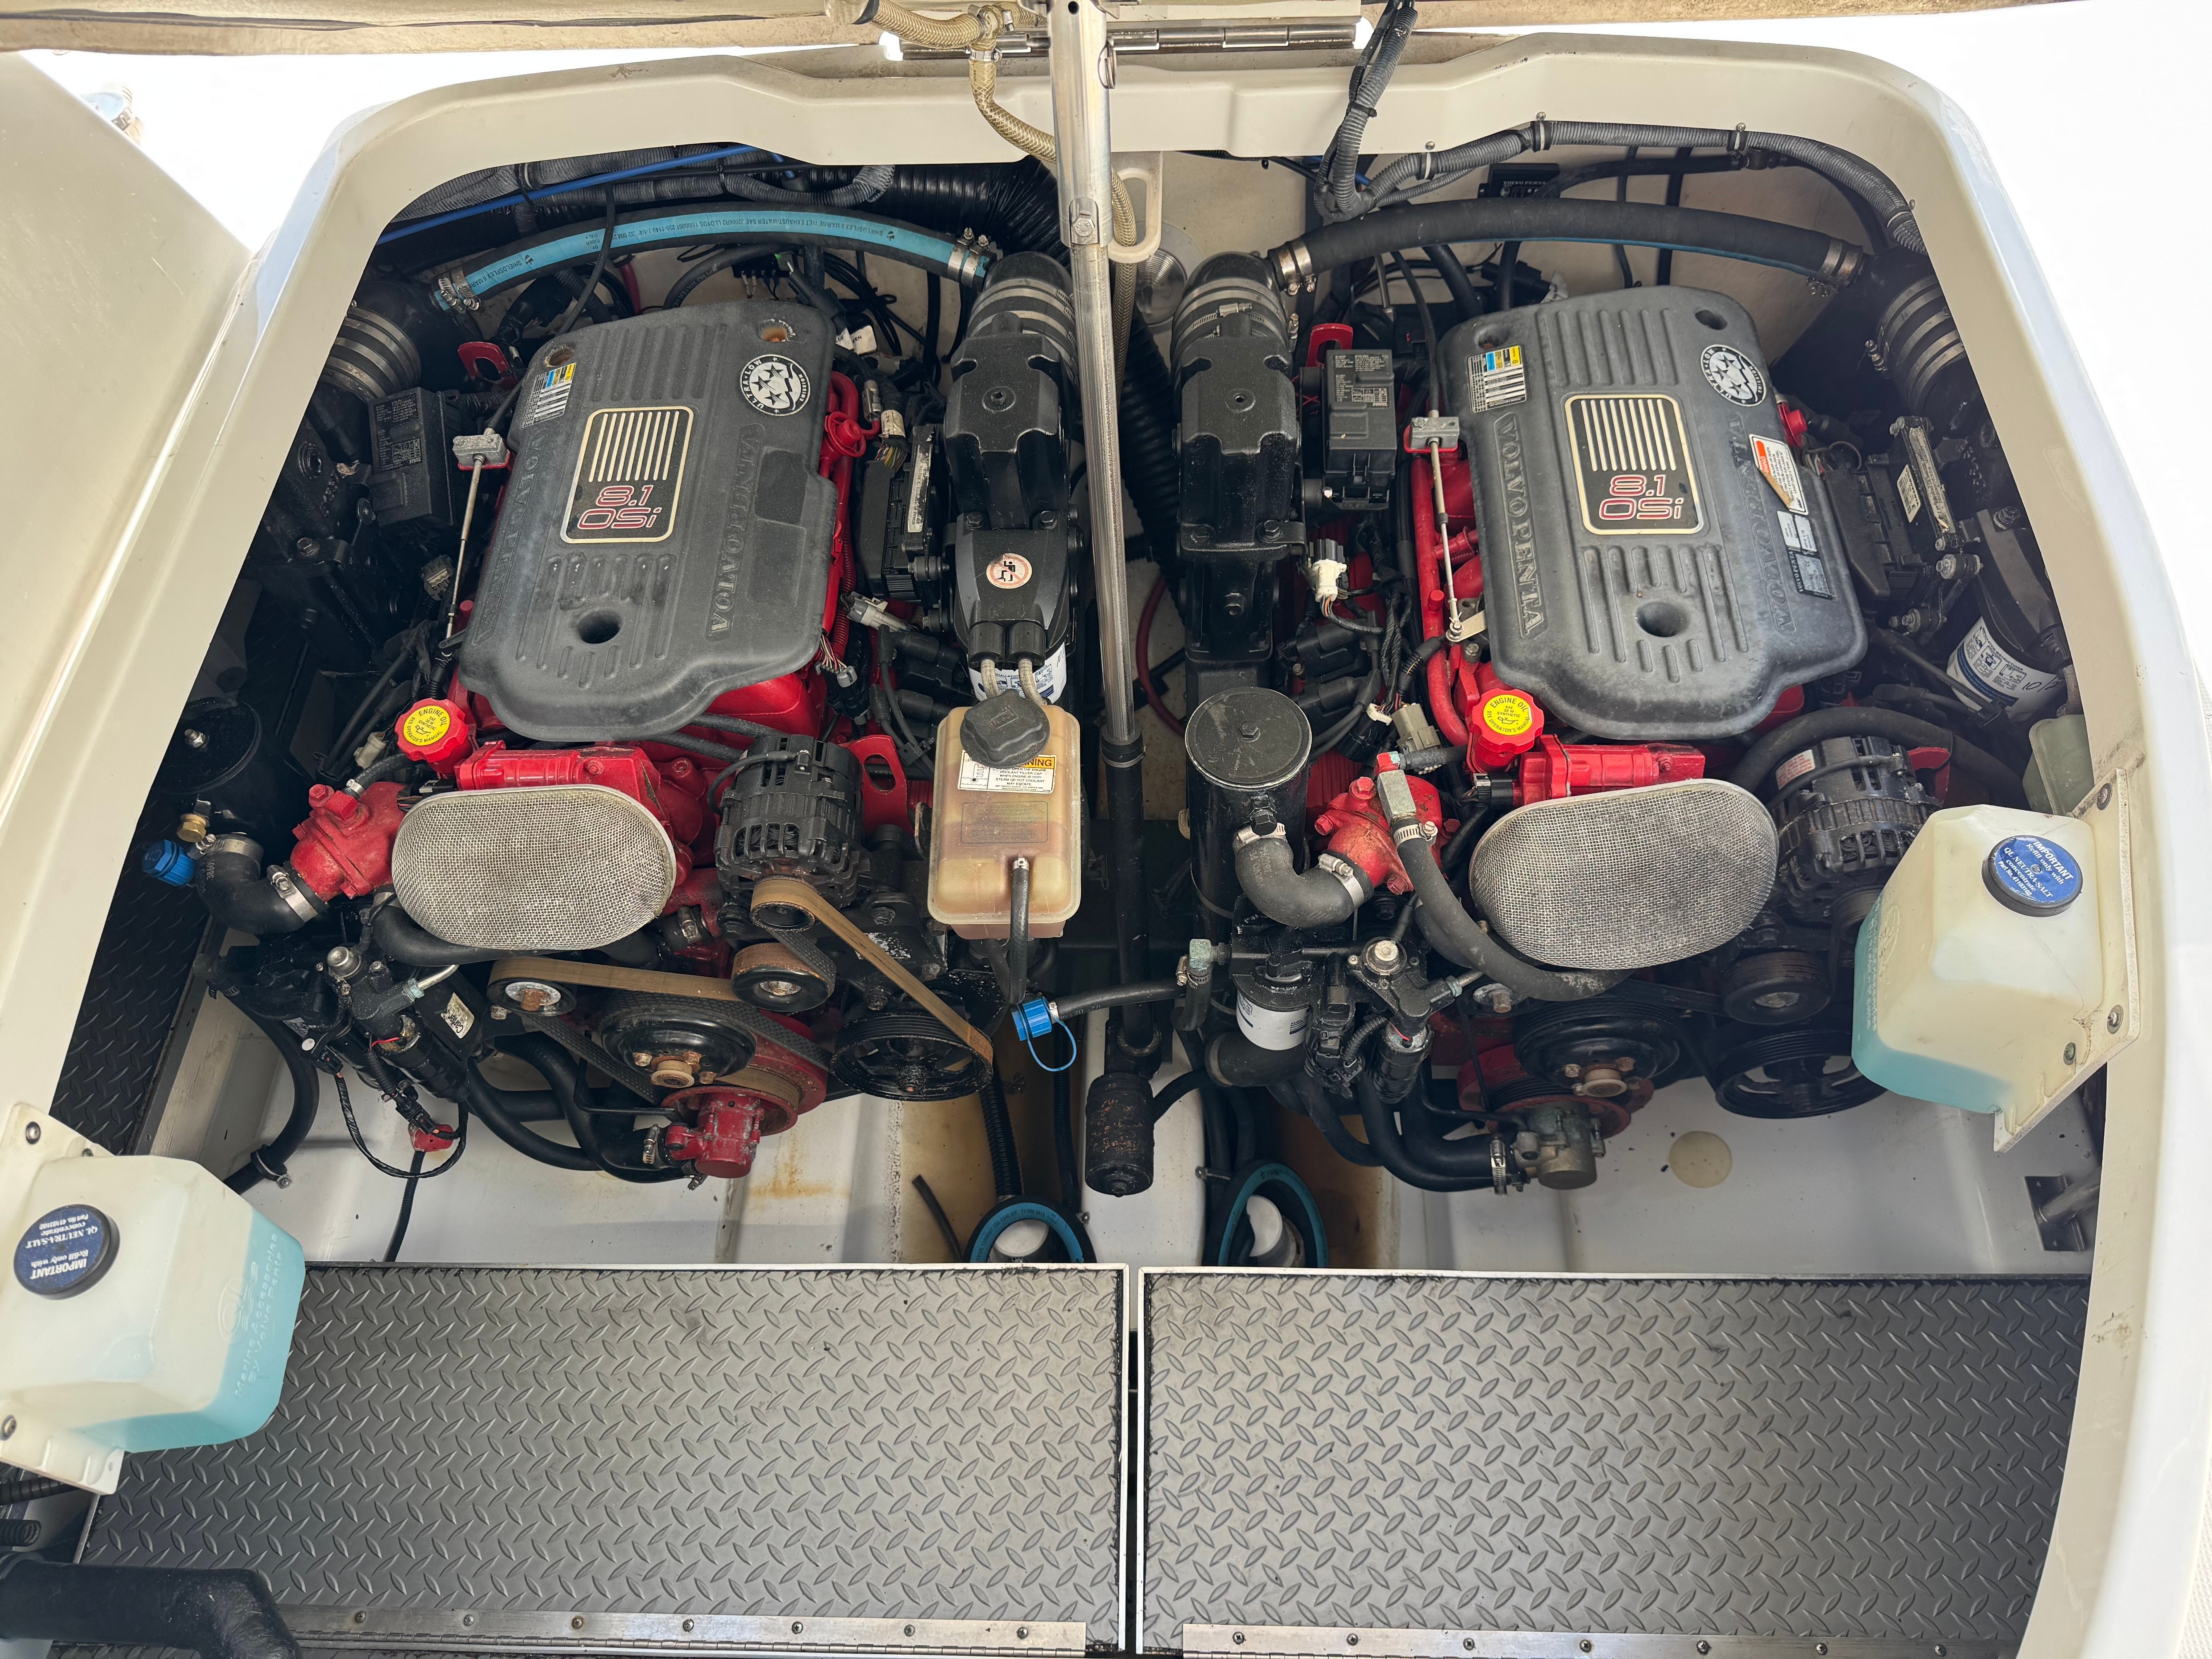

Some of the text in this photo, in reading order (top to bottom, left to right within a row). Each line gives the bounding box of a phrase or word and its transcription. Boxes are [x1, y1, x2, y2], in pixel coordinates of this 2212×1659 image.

[596, 485, 654, 507] 8.1
[1609, 474, 1667, 497] 8.1
[1499, 416, 1545, 636] VOLVO PENTA
[710, 536, 744, 636] VOLVO
[419, 708, 444, 717] ENGINE
[1490, 697, 1528, 712] ENGINE OIL
[424, 731, 443, 742] MANUAL
[1998, 860, 2008, 871] Part
[2026, 843, 2064, 885] Refill only with
[2033, 841, 2074, 880] IMPORTANT
[2004, 847, 2053, 898] QL NEUTRA-SALT
[2006, 859, 2037, 892] concentrate
[447, 1013, 462, 1034] Carter
[25, 1226, 98, 1249] QL NEUTRA-SALT
[41, 1222, 86, 1236] concentrate
[30, 1258, 87, 1279] IMPORTANT
[31, 1250, 89, 1268] Refill only with
[234, 1338, 256, 1397] Marine
